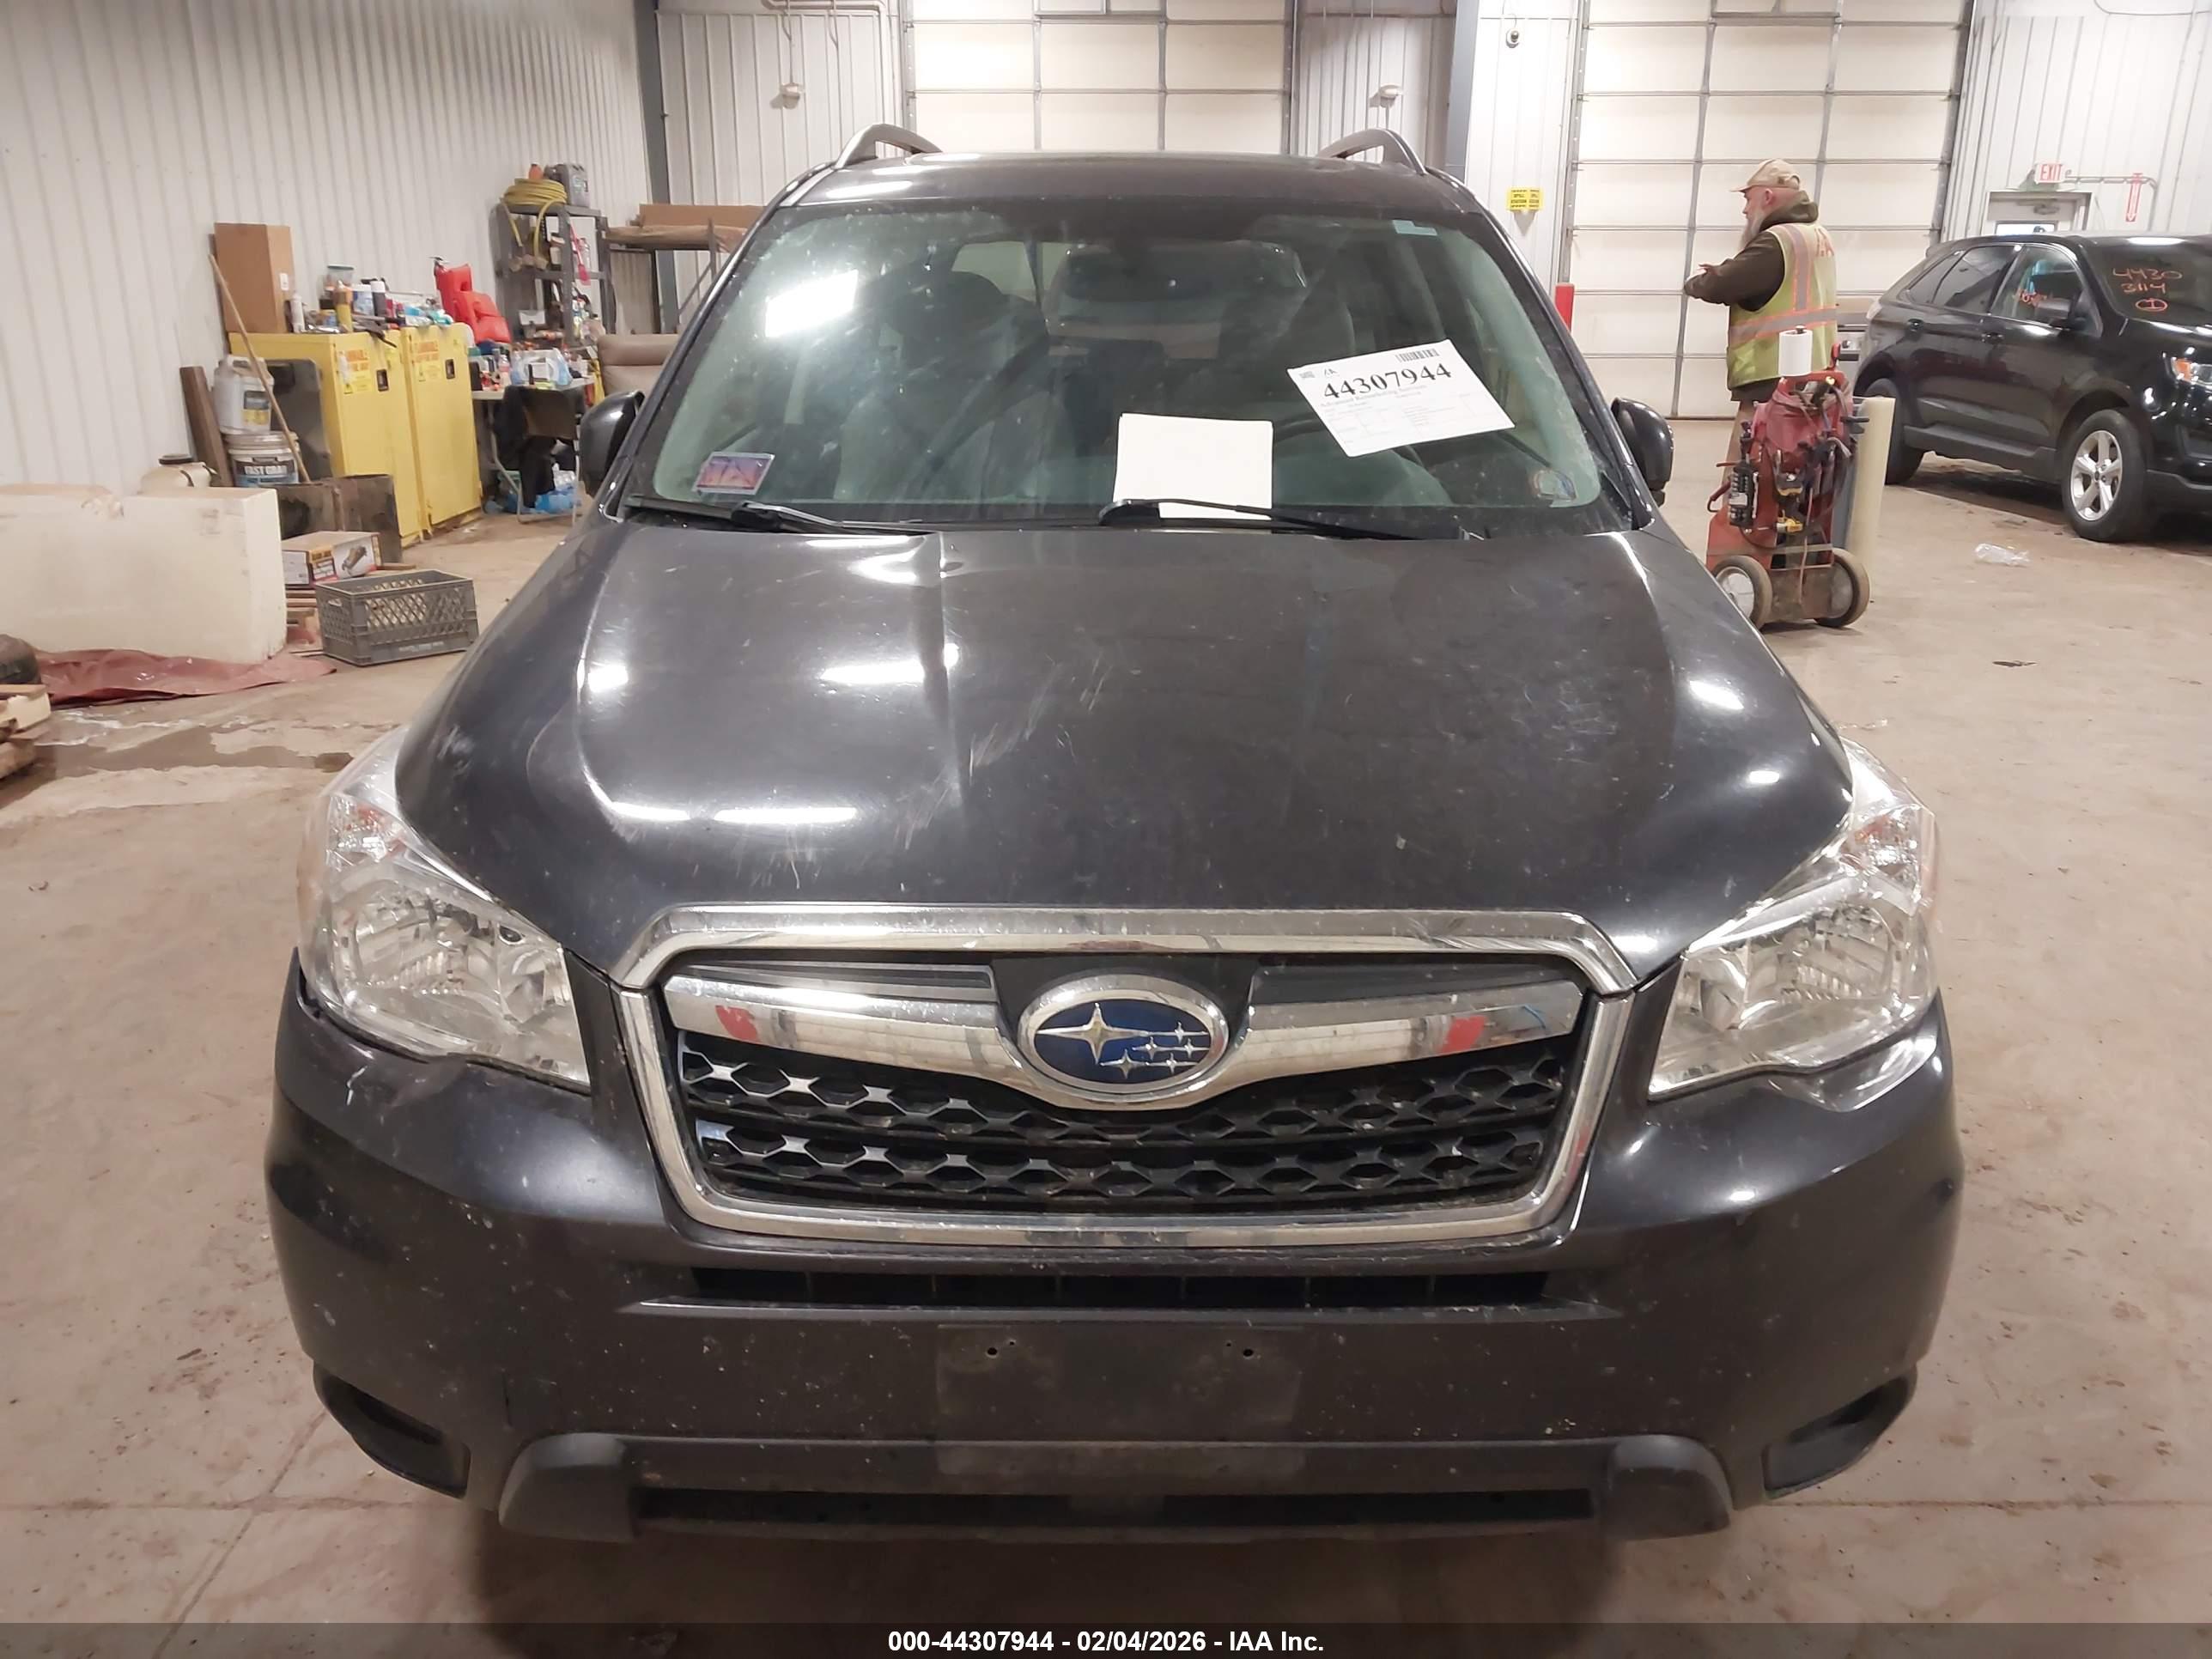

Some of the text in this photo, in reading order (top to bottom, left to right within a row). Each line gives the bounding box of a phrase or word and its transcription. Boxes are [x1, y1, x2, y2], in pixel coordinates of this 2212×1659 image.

[2040, 164, 2063, 180] EXIT
[2112, 268, 2183, 280] 4430
[2121, 282, 2166, 294] 3114
[1323, 362, 1451, 398] 44307944
